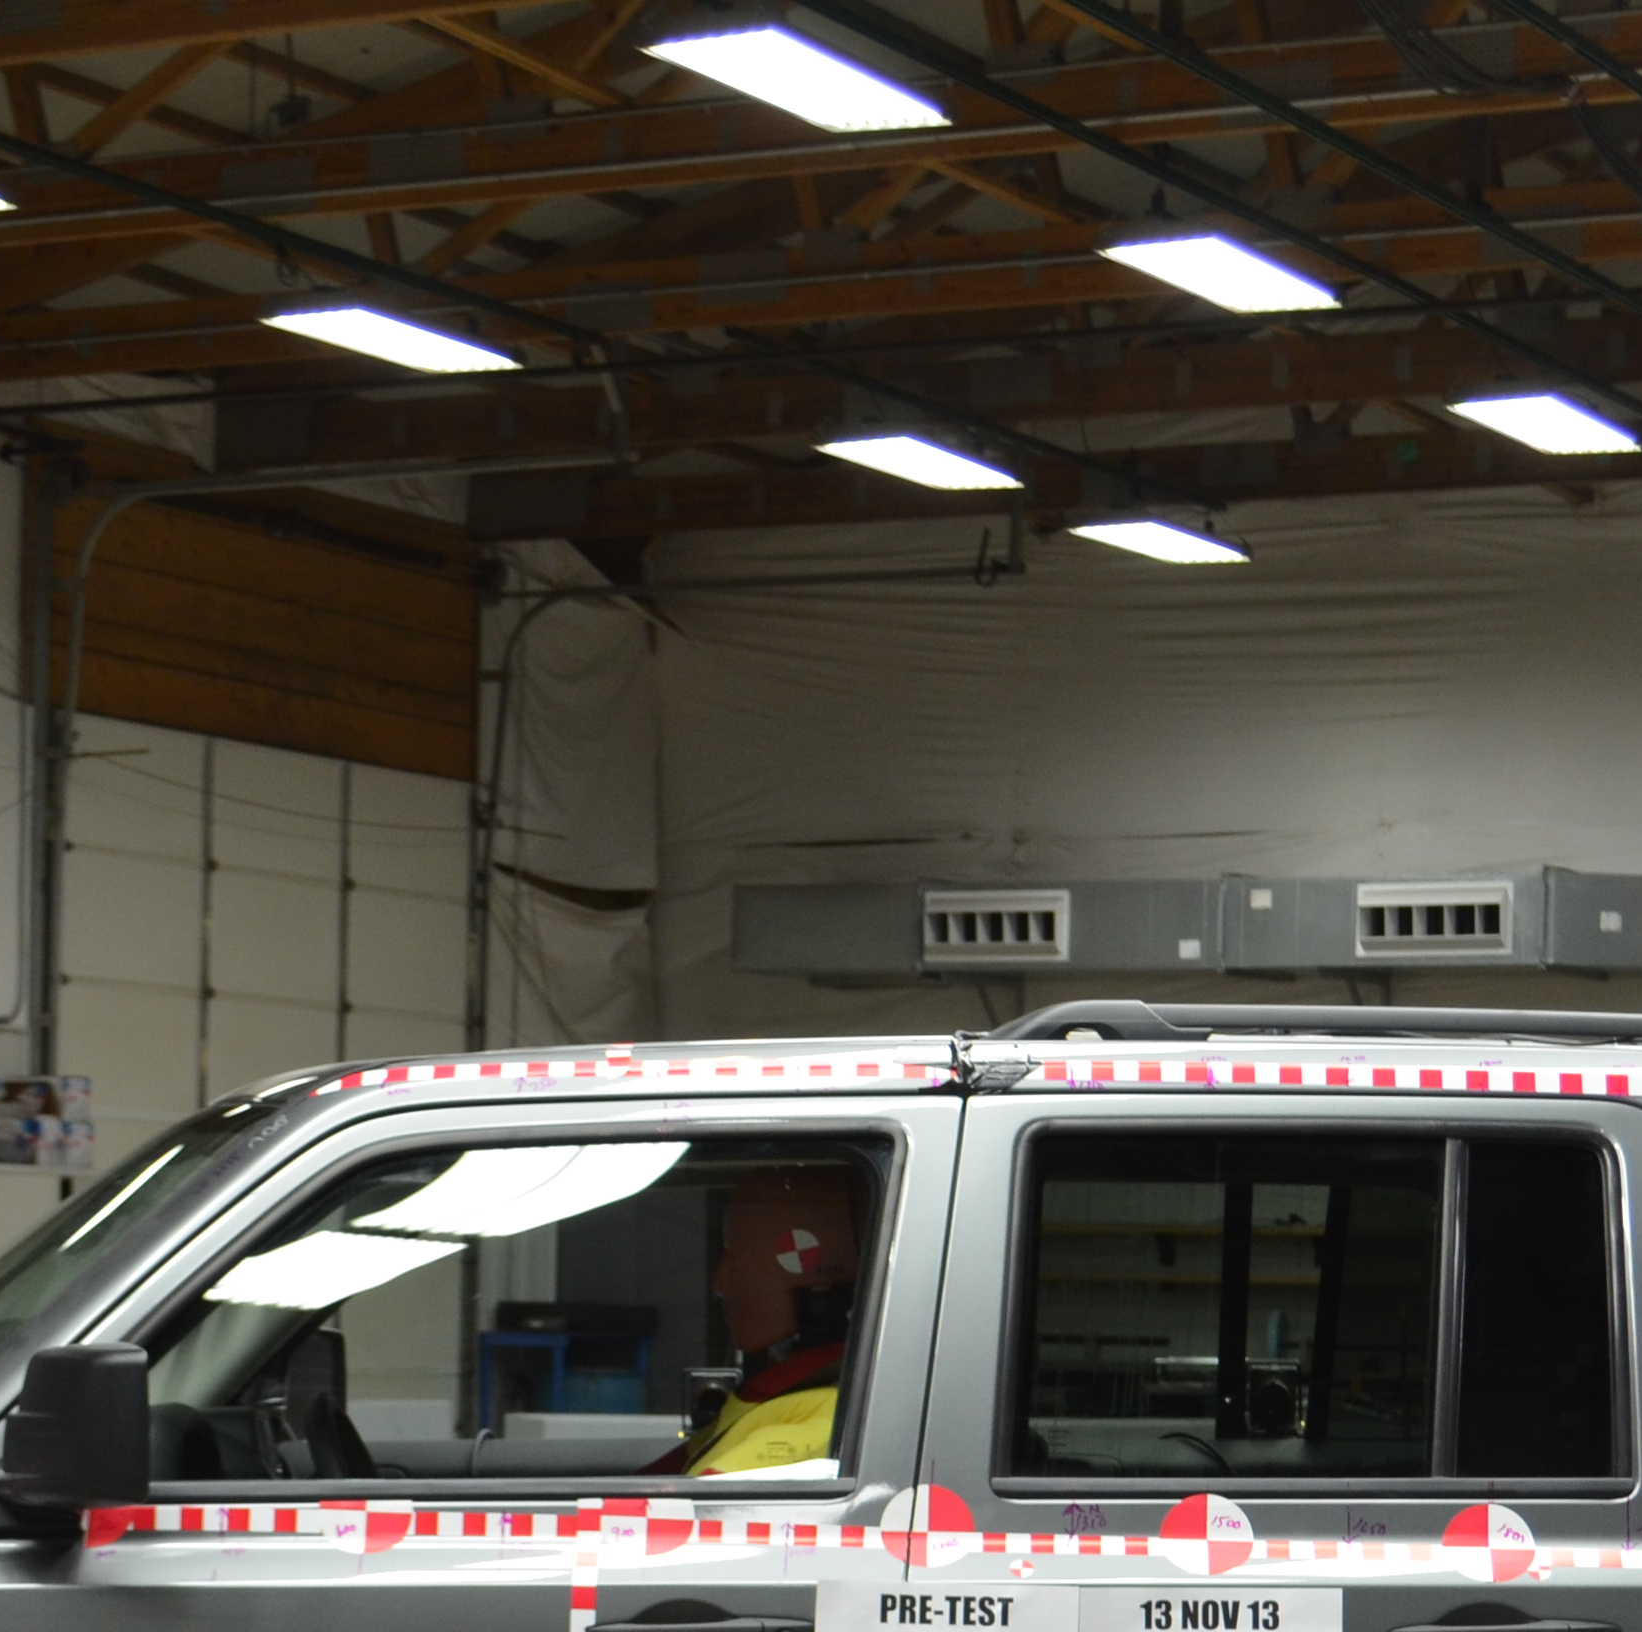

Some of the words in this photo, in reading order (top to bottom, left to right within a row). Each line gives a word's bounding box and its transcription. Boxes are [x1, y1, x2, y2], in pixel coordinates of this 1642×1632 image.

[1212, 1515, 1241, 1529] 1500
[880, 1594, 1014, 1627] PRE-TEST
[1139, 1599, 1172, 1630] 13
[1181, 1600, 1240, 1630] NOV
[1247, 1600, 1280, 1631] 13
